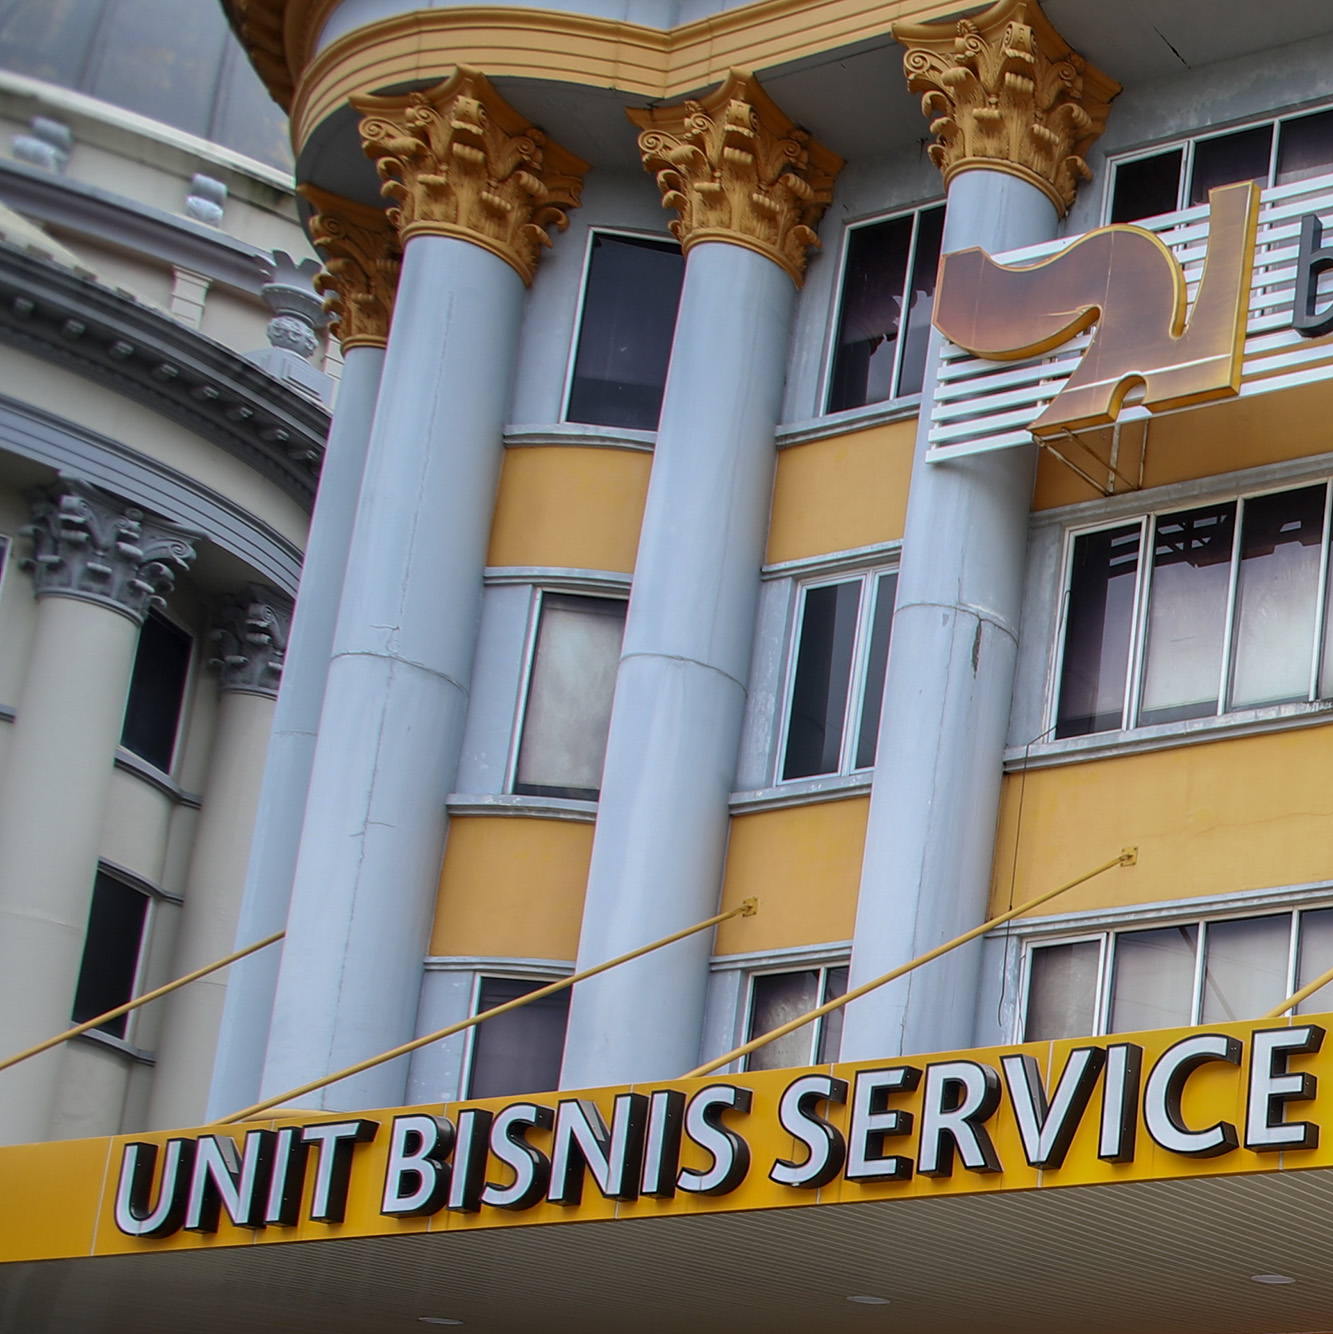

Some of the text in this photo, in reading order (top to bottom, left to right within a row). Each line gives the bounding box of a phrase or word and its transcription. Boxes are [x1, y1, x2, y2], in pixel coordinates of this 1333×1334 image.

[114, 1024, 1327, 1239] UNIT BISNIS SERVICE
